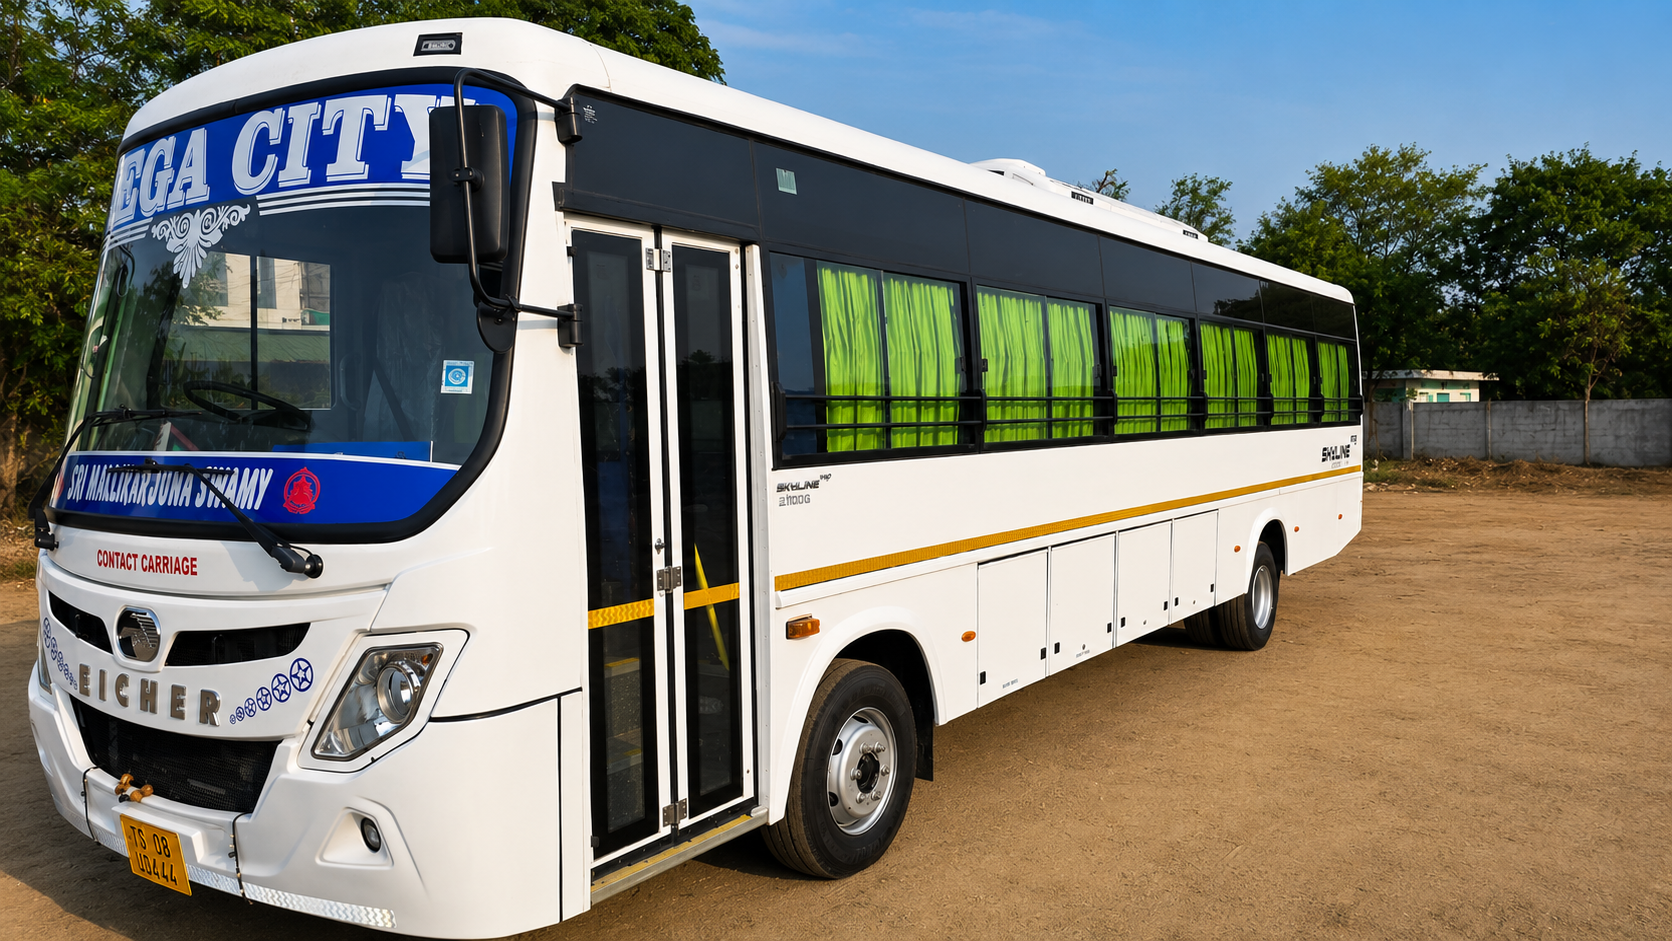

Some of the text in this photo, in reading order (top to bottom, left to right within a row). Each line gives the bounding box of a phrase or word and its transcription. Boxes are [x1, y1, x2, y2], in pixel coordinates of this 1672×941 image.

[112, 127, 210, 226] EGA
[67, 464, 89, 503] SRI
[195, 466, 273, 510] SWAMY
[97, 549, 198, 576] CONTACT CARRIAGE
[79, 663, 221, 727] EICHER
[130, 825, 171, 858] TS 08
[135, 851, 178, 886] UD444
